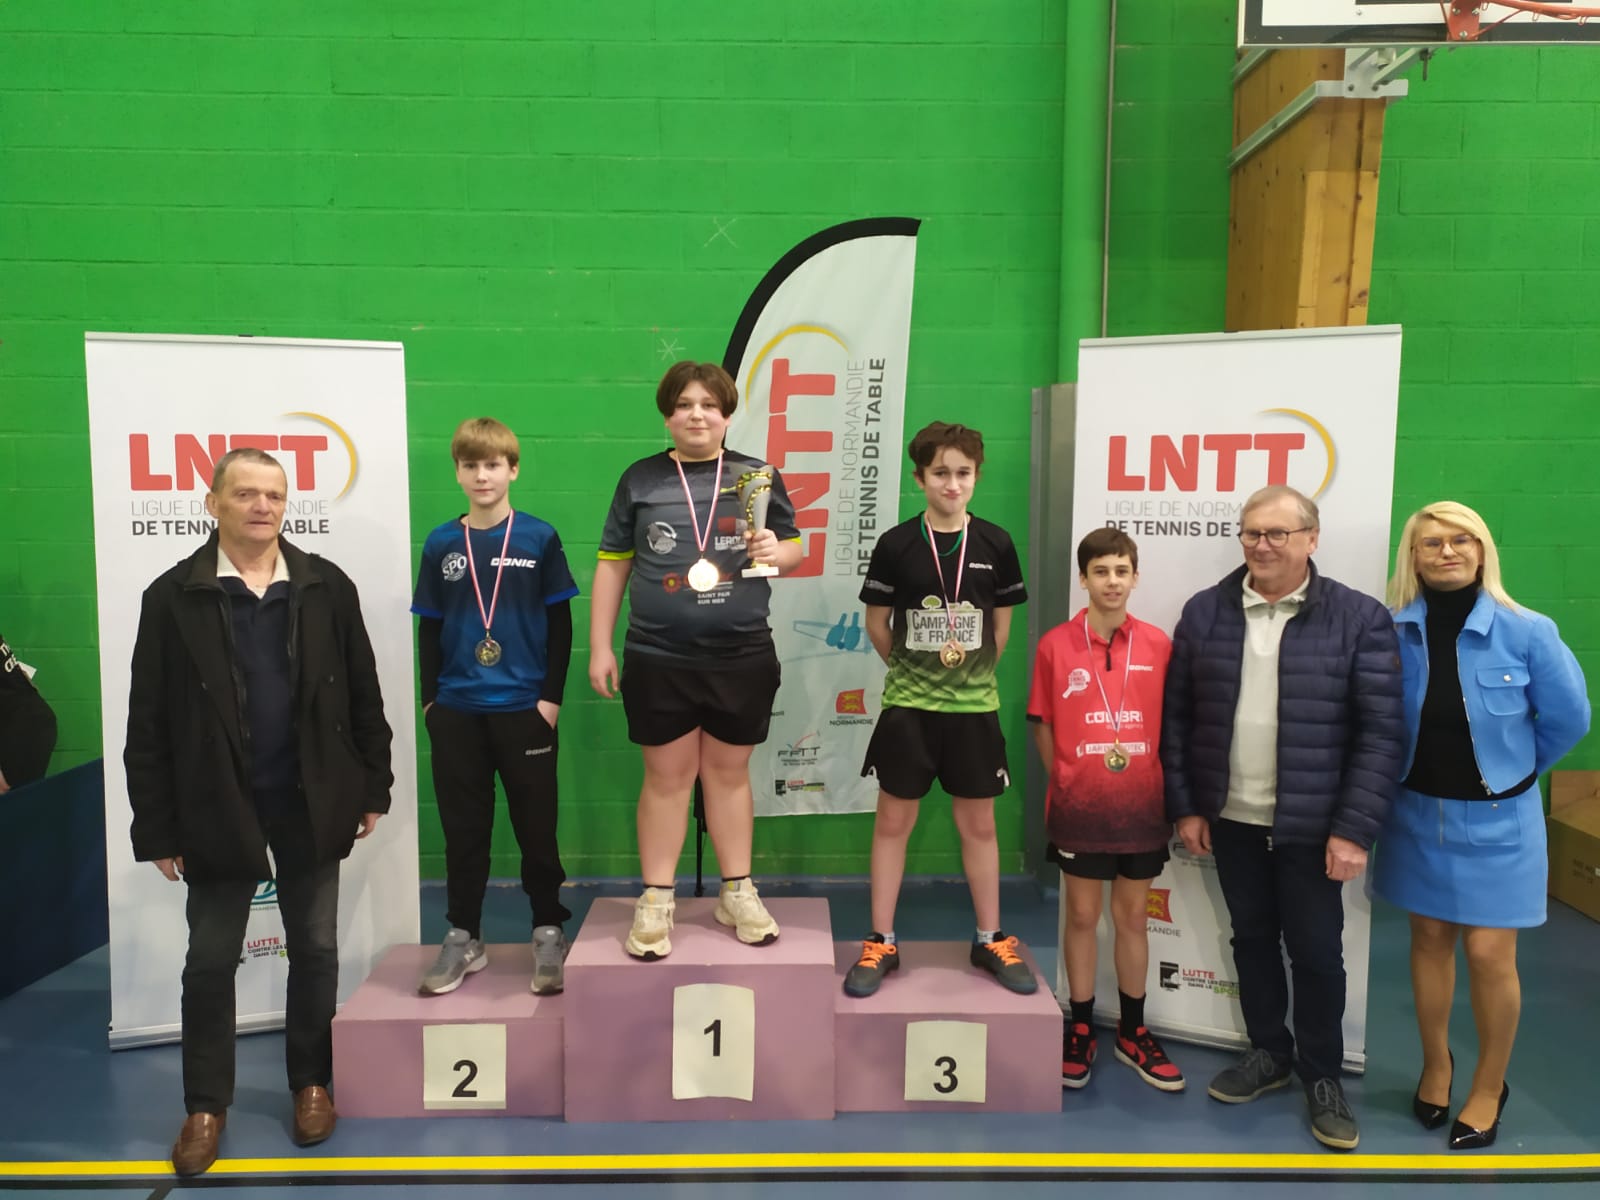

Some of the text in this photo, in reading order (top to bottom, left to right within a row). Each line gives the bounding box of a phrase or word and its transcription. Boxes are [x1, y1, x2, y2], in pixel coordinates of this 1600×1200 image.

[766, 358, 836, 577] LNTT
[834, 359, 865, 576] LIGUE DE NORMANDIE
[857, 358, 886, 576] DE TENNIS DE TABLE
[1107, 432, 1306, 493] LNTT
[131, 499, 185, 517] LIGUE
[1105, 500, 1153, 517] LIGUE
[1159, 501, 1182, 518] DE
[131, 519, 330, 536] DE TENN ABLE
[1132, 520, 1202, 537] TENNIS
[1206, 521, 1232, 538] DE
[442, 555, 468, 581] SPO
[490, 557, 537, 569] DONIC
[929, 630, 975, 643] FRANCE
[1148, 926, 1182, 938] ANDIE
[247, 938, 279, 948] LUTTE
[1182, 969, 1215, 979] LUTTE
[1213, 985, 1240, 996] SPO
[703, 1018, 721, 1057] 1
[451, 1059, 478, 1098] 2
[932, 1055, 959, 1093] 3
